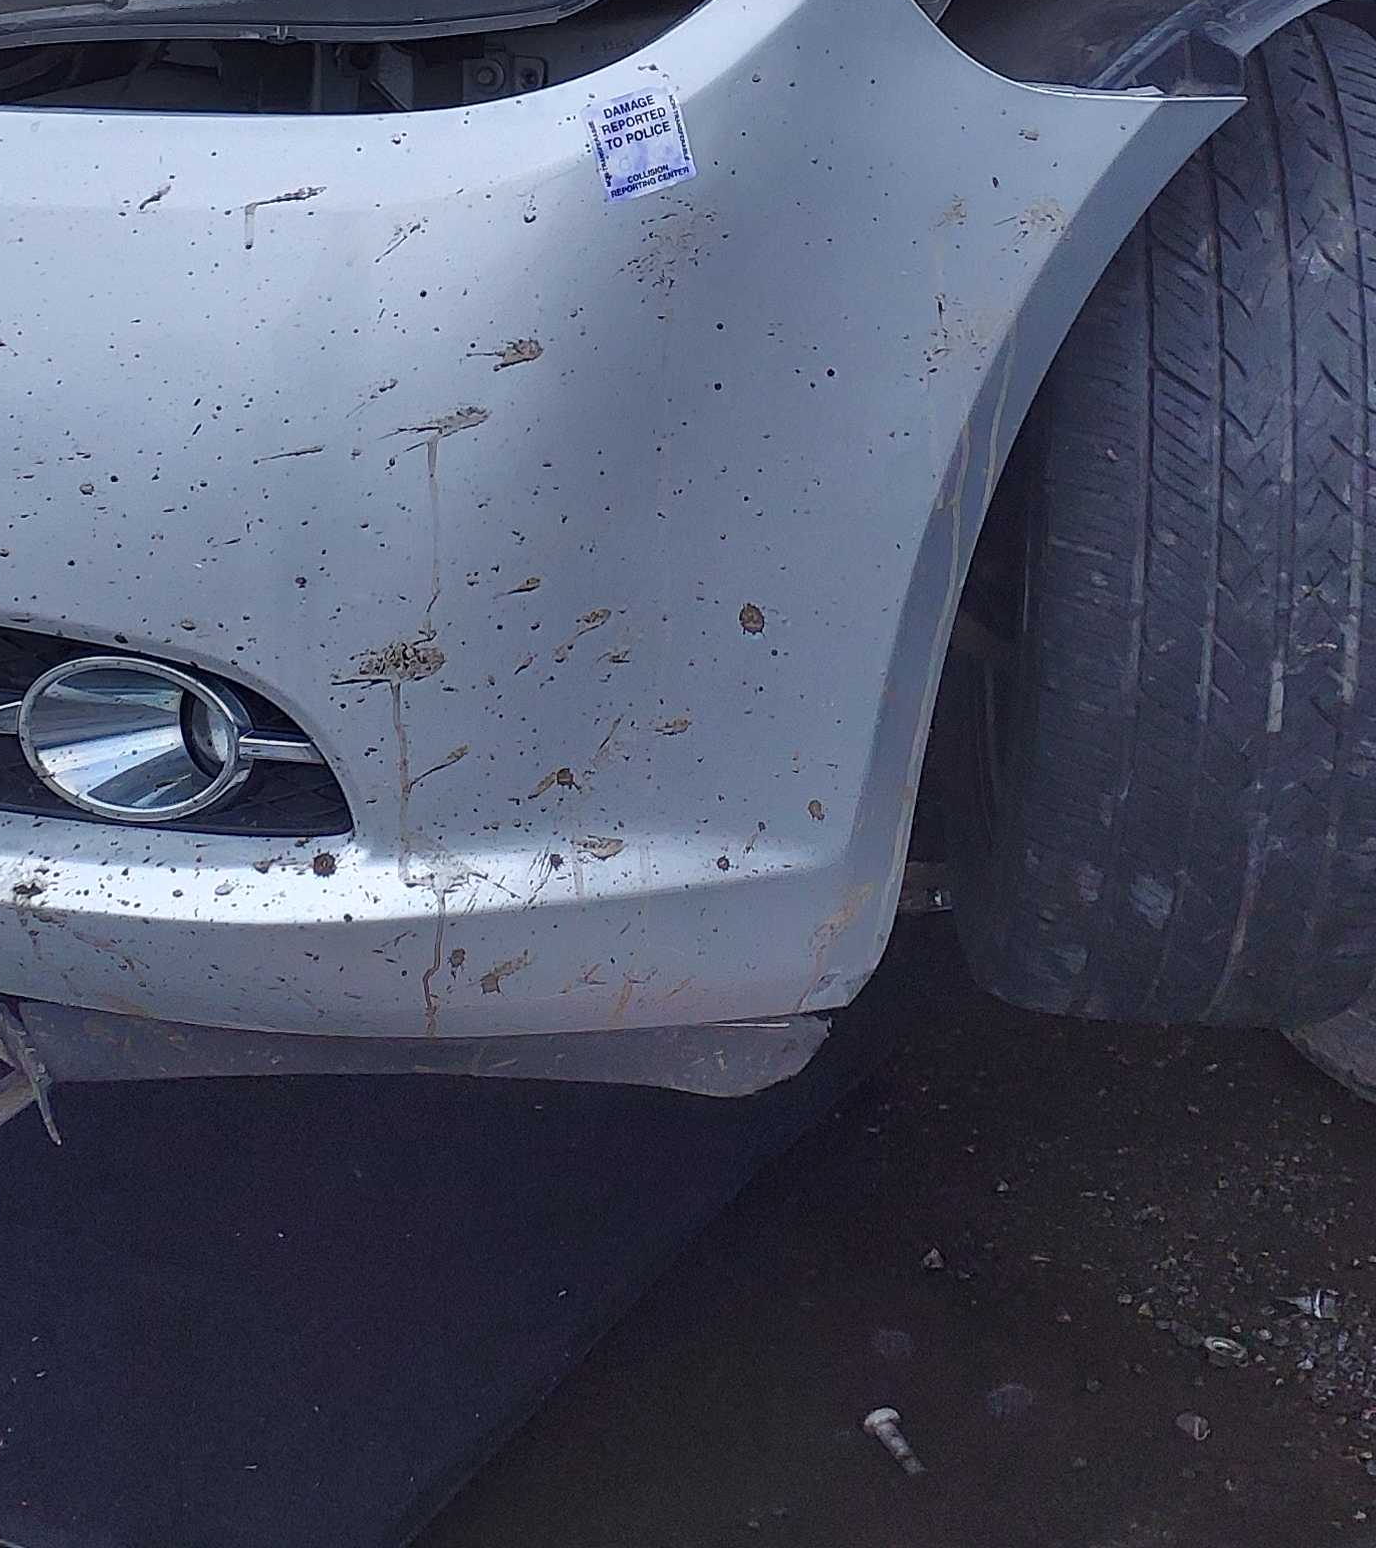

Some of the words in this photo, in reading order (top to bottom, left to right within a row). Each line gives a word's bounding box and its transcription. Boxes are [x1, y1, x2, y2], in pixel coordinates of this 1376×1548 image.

[603, 94, 655, 119] DAMAGE
[601, 107, 666, 135] REPORTED
[605, 137, 623, 150] TO
[626, 121, 671, 144] POLICE
[627, 164, 669, 184] COLLISION
[610, 177, 656, 198] REPORTING
